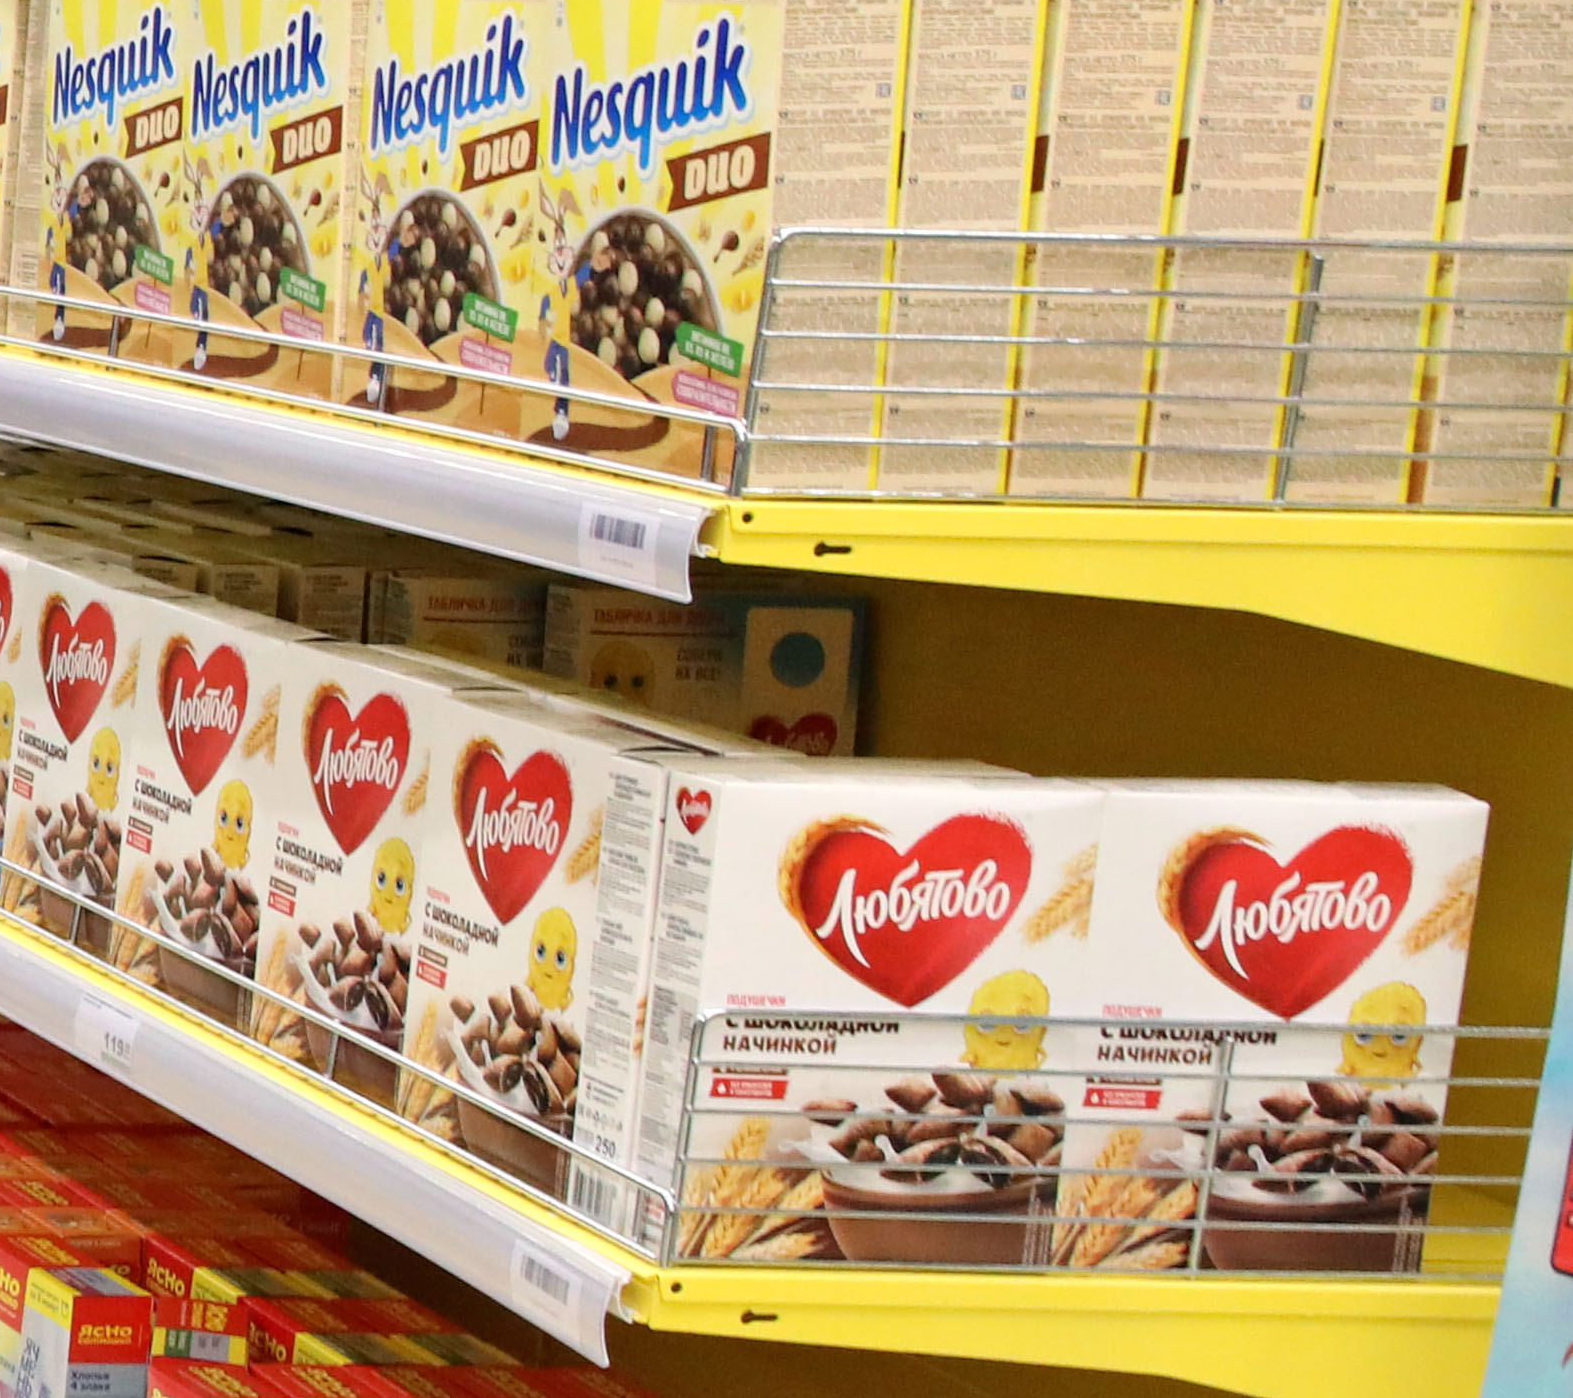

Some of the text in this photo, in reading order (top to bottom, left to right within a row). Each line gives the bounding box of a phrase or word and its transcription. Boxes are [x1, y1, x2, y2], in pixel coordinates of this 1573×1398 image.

[53, 6, 174, 125] Nesquik
[191, 11, 326, 139] Nesquik
[371, 14, 525, 153] Nesquik
[551, 17, 747, 171] Nesquik
[135, 104, 180, 148] DUO
[281, 116, 332, 162] DUO
[473, 129, 531, 182] DUO
[684, 144, 756, 200] DUO
[46, 632, 107, 707] Любятово
[167, 678, 238, 758] Любятово
[140, 782, 192, 816] ШОКОЛАДНОЙ
[313, 728, 398, 816] Любятово
[283, 840, 342, 876] ШОКОЛАДНОЙ
[466, 786, 559, 881] Любятово
[274, 856, 316, 884] НАЧИНКОЙ
[423, 922, 469, 956] НАЧИНКОЙ
[425, 902, 498, 949] С ШОКОЛАДНОЙ
[816, 859, 1011, 968] Любятово
[1194, 871, 1391, 980] Любятово
[723, 1032, 836, 1055] НАЧИНКОЙ
[1097, 1043, 1212, 1066] НАЧИНКОЙ
